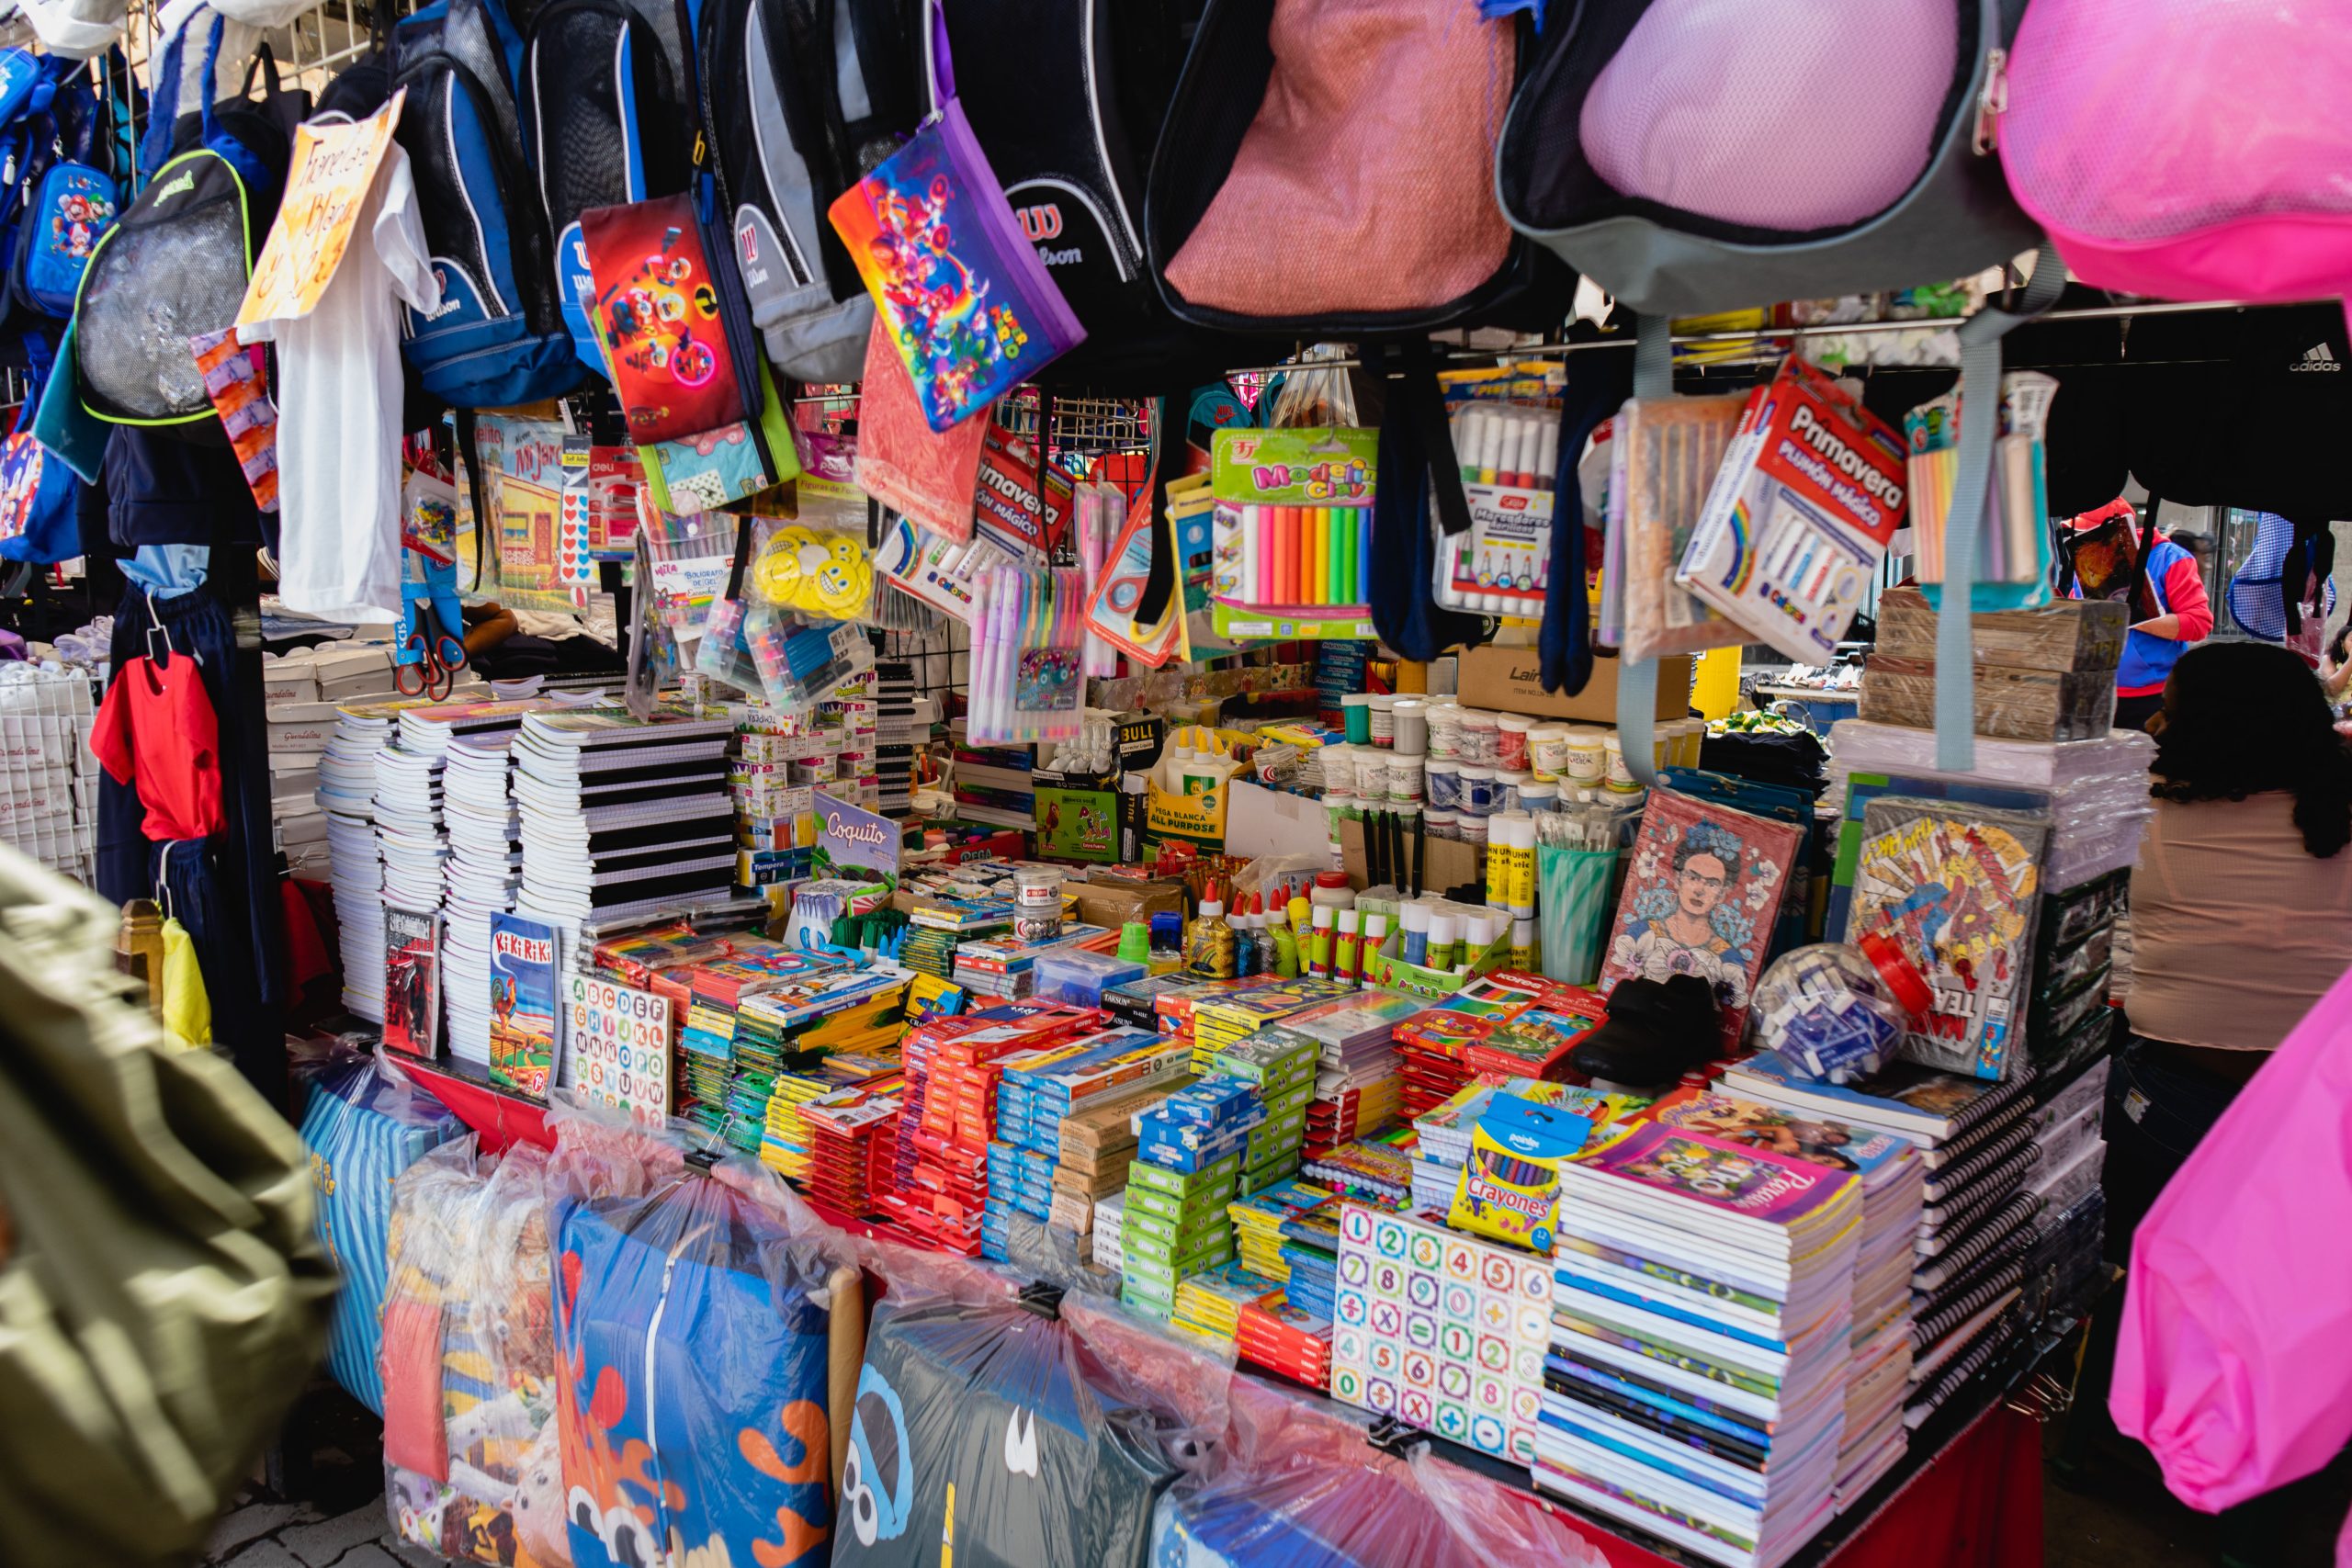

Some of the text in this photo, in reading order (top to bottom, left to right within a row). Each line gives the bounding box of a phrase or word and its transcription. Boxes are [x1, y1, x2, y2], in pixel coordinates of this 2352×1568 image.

[1039, 246, 1082, 265] lson
[2290, 359, 2341, 371] adidas
[1790, 404, 1905, 510] Primavera
[593, 462, 614, 472] deli
[1252, 457, 1376, 491] Modelin
[800, 479, 828, 492] Figuras
[1306, 480, 1366, 500] Clay
[1121, 724, 1154, 742] BULL
[1155, 806, 1206, 822] PEGA BLANCA
[827, 812, 887, 848] Coquito
[1150, 814, 1216, 833] ALL PURPOSE
[753, 860, 785, 872] Tempera
[1467, 1177, 1549, 1219] Crayones
[1536, 1229, 1547, 1240] 12
